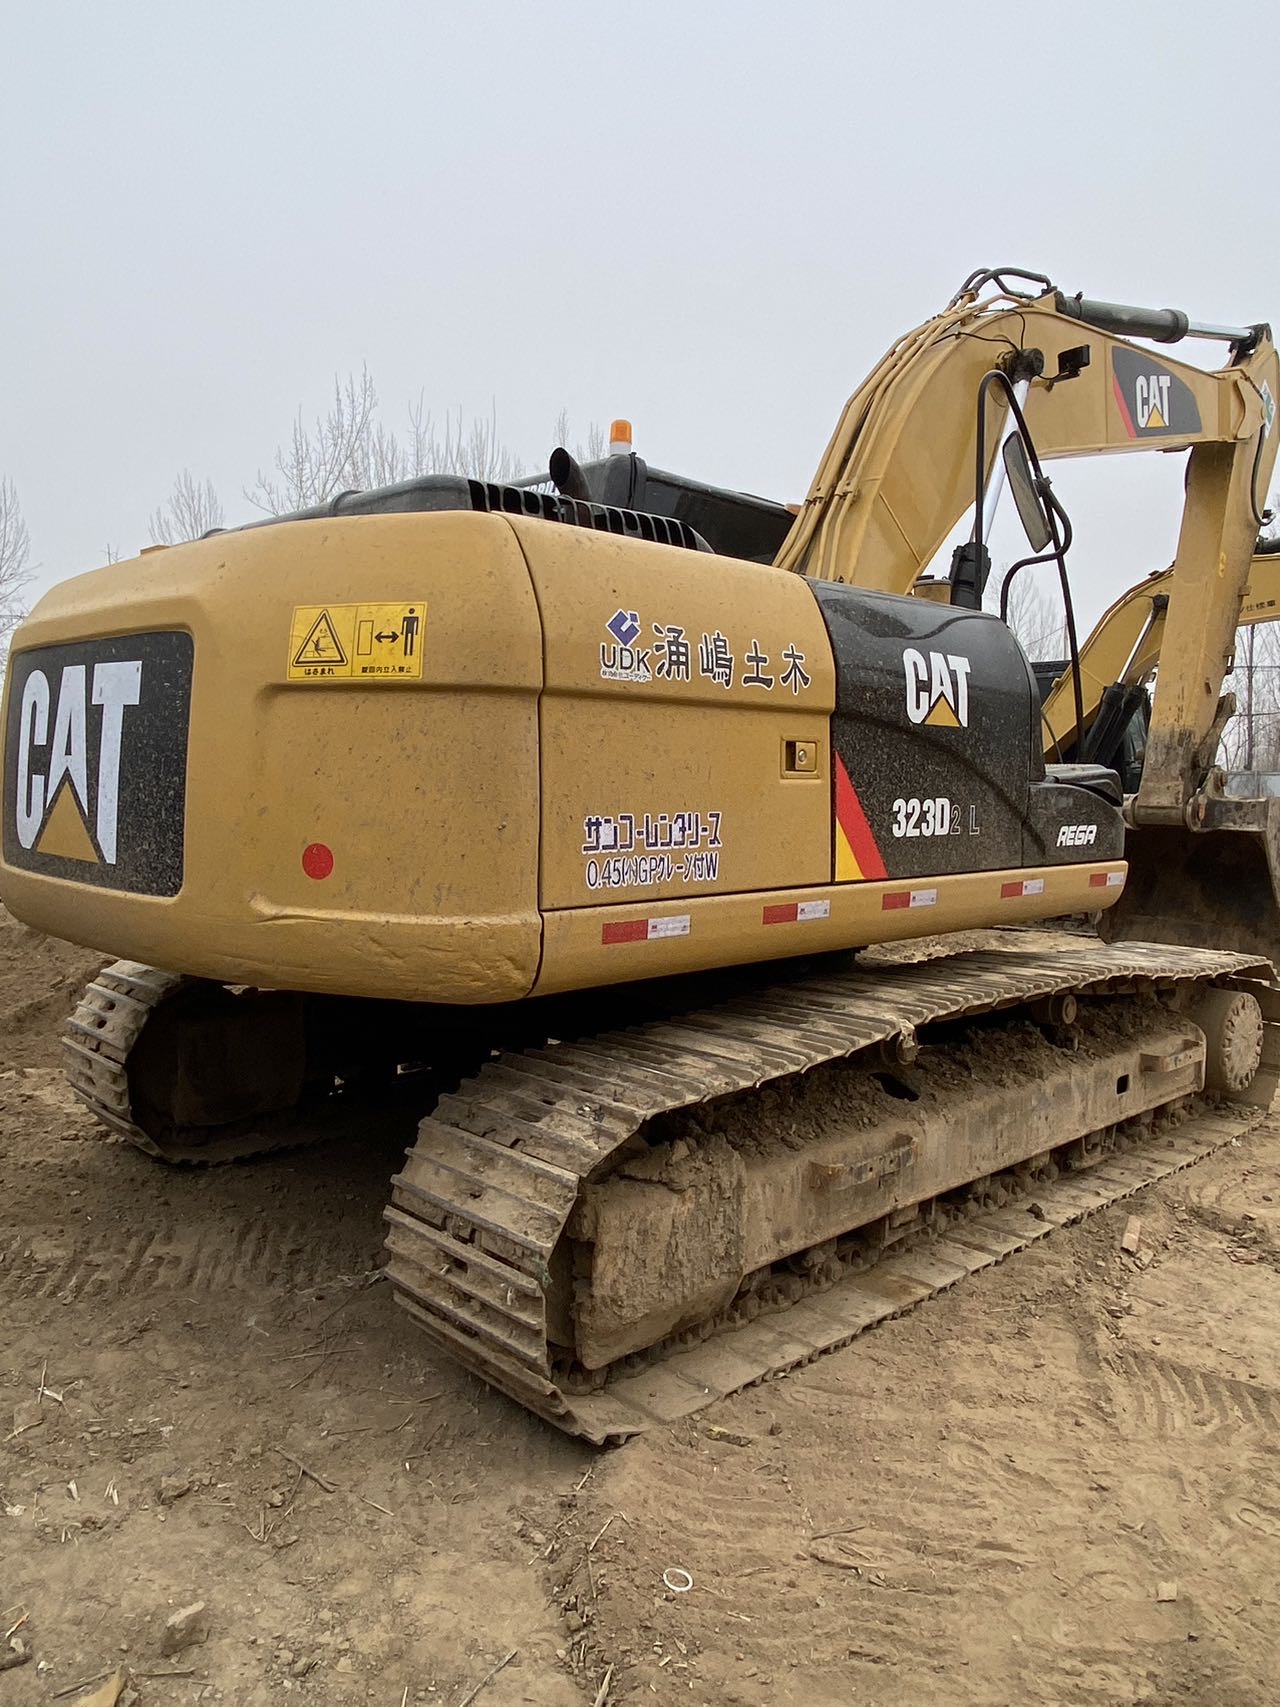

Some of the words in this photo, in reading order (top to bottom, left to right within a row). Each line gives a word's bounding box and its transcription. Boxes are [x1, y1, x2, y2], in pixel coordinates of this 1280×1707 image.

[1135, 374, 1172, 428] CAT
[304, 667, 335, 676] はさまれ
[601, 644, 652, 673] UDK
[653, 624, 811, 694] 涌嶋土木
[903, 648, 971, 728] CAT
[16, 660, 143, 865] CAT
